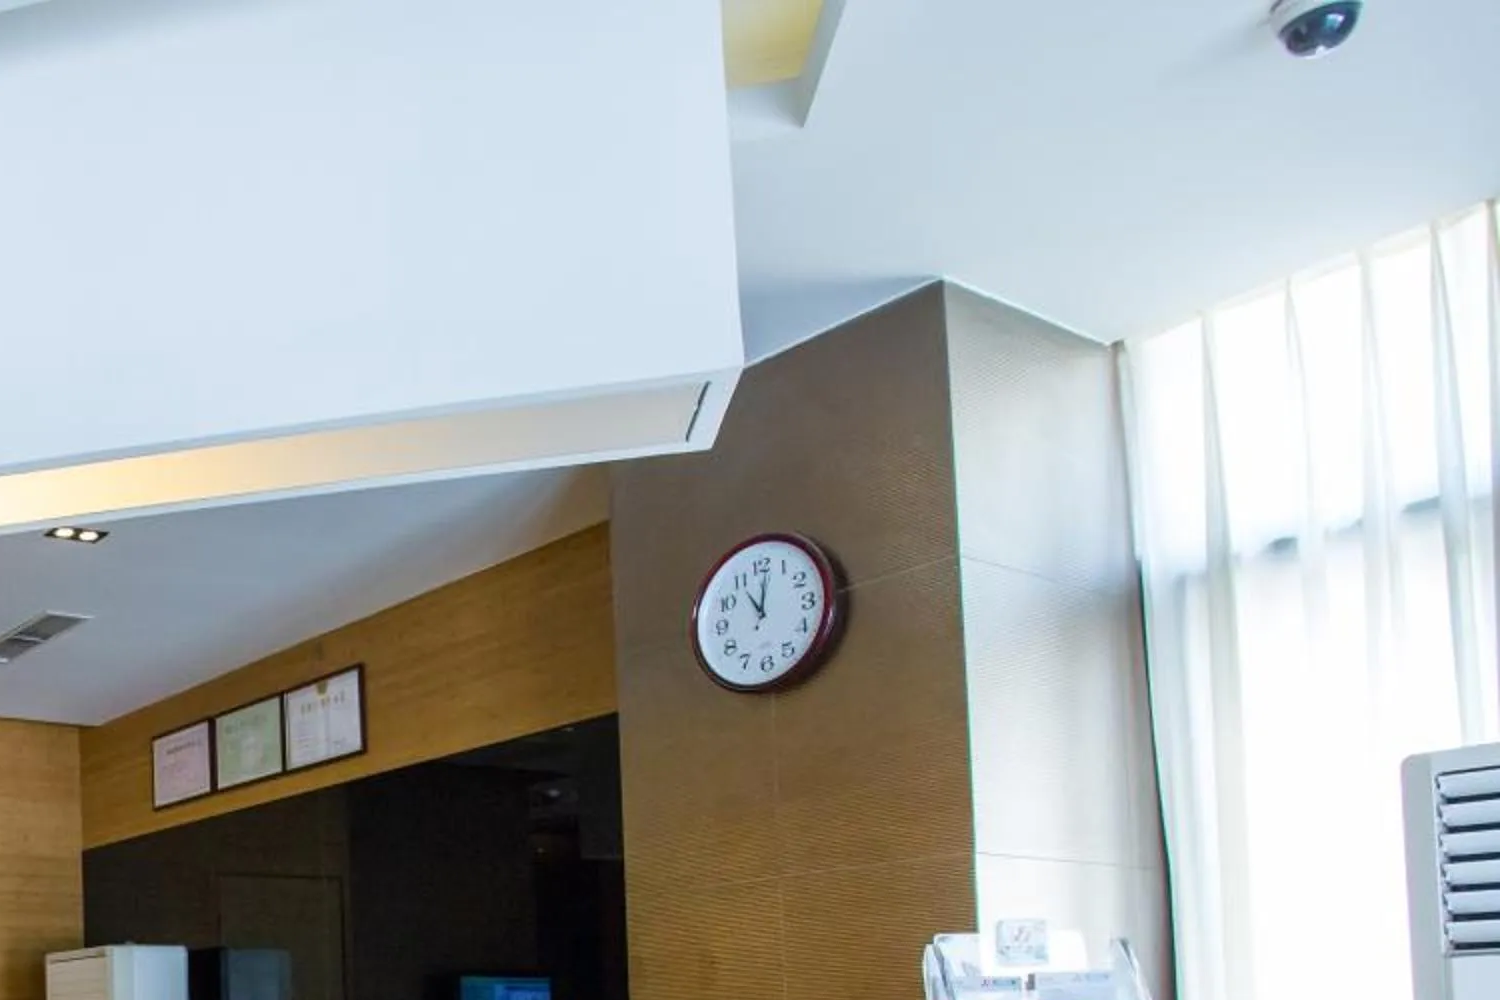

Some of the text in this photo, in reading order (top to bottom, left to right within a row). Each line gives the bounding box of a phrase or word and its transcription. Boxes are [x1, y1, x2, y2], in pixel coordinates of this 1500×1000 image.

[753, 557, 771, 576] 12
[781, 559, 787, 575] 1
[734, 572, 747, 590] 11
[792, 571, 807, 588] 2
[720, 594, 737, 612] 10
[801, 591, 816, 610] 3
[715, 619, 729, 635] 9
[794, 617, 807, 634] 4
[723, 639, 737, 656] 8
[781, 641, 795, 658] 5
[739, 653, 751, 670] 7
[760, 655, 774, 672] 6
